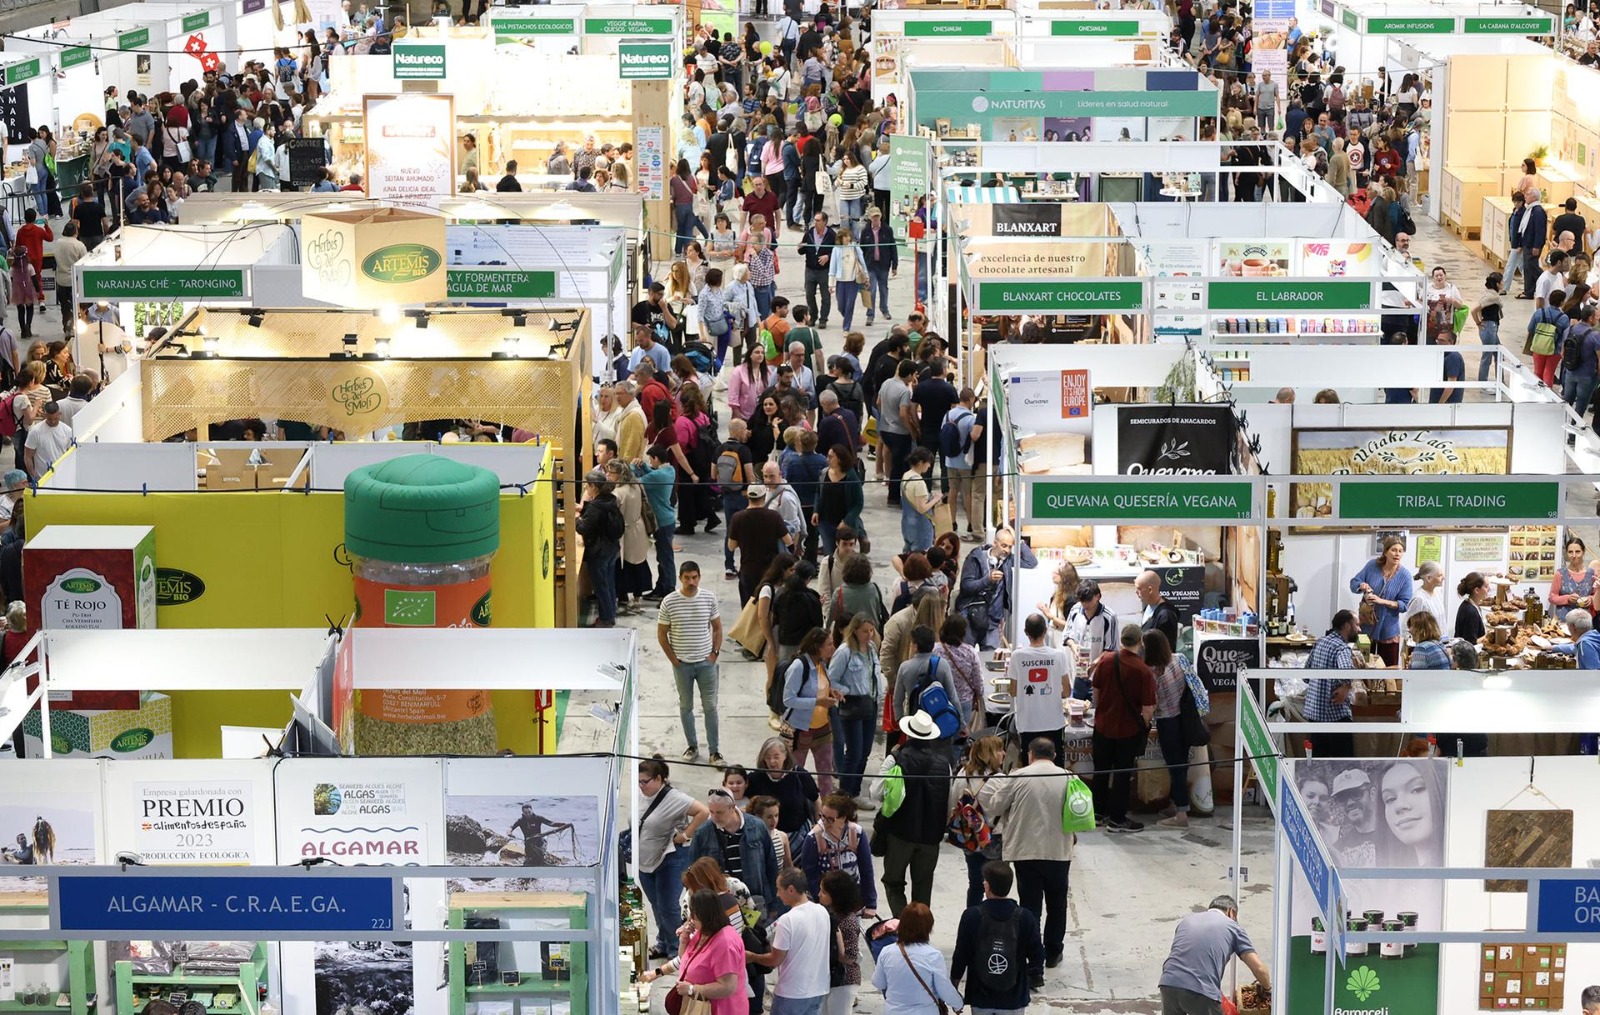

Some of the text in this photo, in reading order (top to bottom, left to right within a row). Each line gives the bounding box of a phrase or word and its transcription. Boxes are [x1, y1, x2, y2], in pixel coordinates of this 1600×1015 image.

[395, 53, 444, 64] Natureco
[621, 54, 669, 64] Natureco
[991, 101, 1046, 109] NATURITAS
[1077, 99, 1104, 108] Líderes
[1118, 100, 1138, 108] salud
[1140, 100, 1168, 108] natural
[996, 223, 1057, 232] BLANXART
[981, 254, 1031, 262] excelencia
[1034, 254, 1045, 262] de
[372, 254, 430, 274] ARTEMIS
[97, 280, 147, 289] NARANJAS
[150, 277, 169, 289] CHÉ
[179, 279, 237, 289] TARONGINO
[465, 274, 530, 282] FORMENTERA
[447, 284, 513, 293] AGUA DE MAR
[1003, 292, 1121, 301] BLANXART CHOCOLATES
[1256, 291, 1323, 301] EL LABRADOR
[1064, 375, 1086, 387] ENJOY
[1064, 396, 1086, 406] EUROPE
[1047, 492, 1237, 508] QUEVANA QUESERÍA VEGANA
[1397, 496, 1506, 507] TRIBAL TRADING
[54, 599, 70, 610] TÉ
[1202, 646, 1238, 663] Que
[143, 788, 176, 797] Empresa
[178, 788, 226, 797] galardonada
[344, 790, 375, 798] ALGAS
[142, 798, 244, 817] PREMIO
[360, 805, 390, 814] ALGAS
[176, 833, 213, 847] 2023
[302, 840, 419, 856] ALGAMAR
[107, 896, 203, 912] ALGAMAR
[225, 896, 346, 913] C.R.A.E.GA.
[372, 918, 392, 929] 22J
